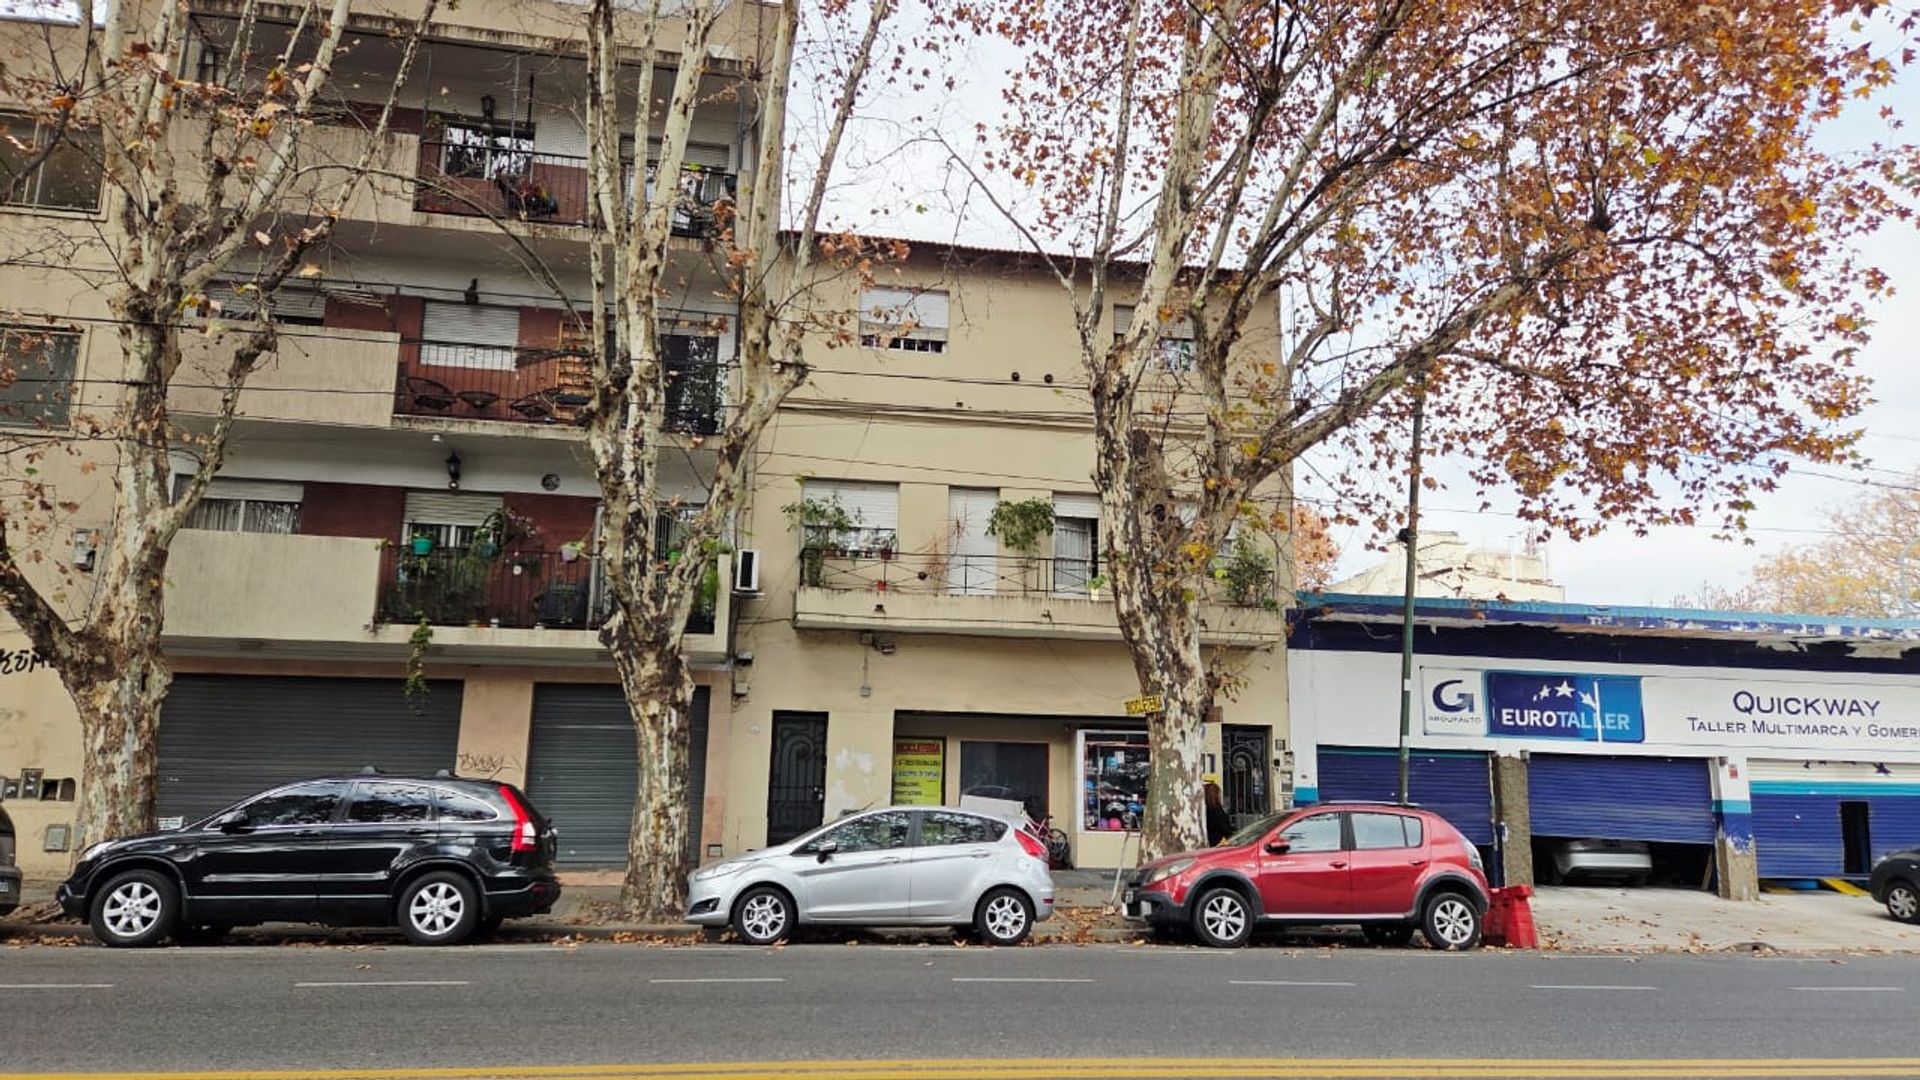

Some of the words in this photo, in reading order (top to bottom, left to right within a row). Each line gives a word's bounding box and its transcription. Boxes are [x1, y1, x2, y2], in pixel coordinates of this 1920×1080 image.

[1733, 690, 1880, 716] QUICKWAY
[1501, 708, 1631, 730] EUROTALLER
[1687, 717, 1746, 733] TALLER
[1752, 720, 1848, 736] MULTIMARCA
